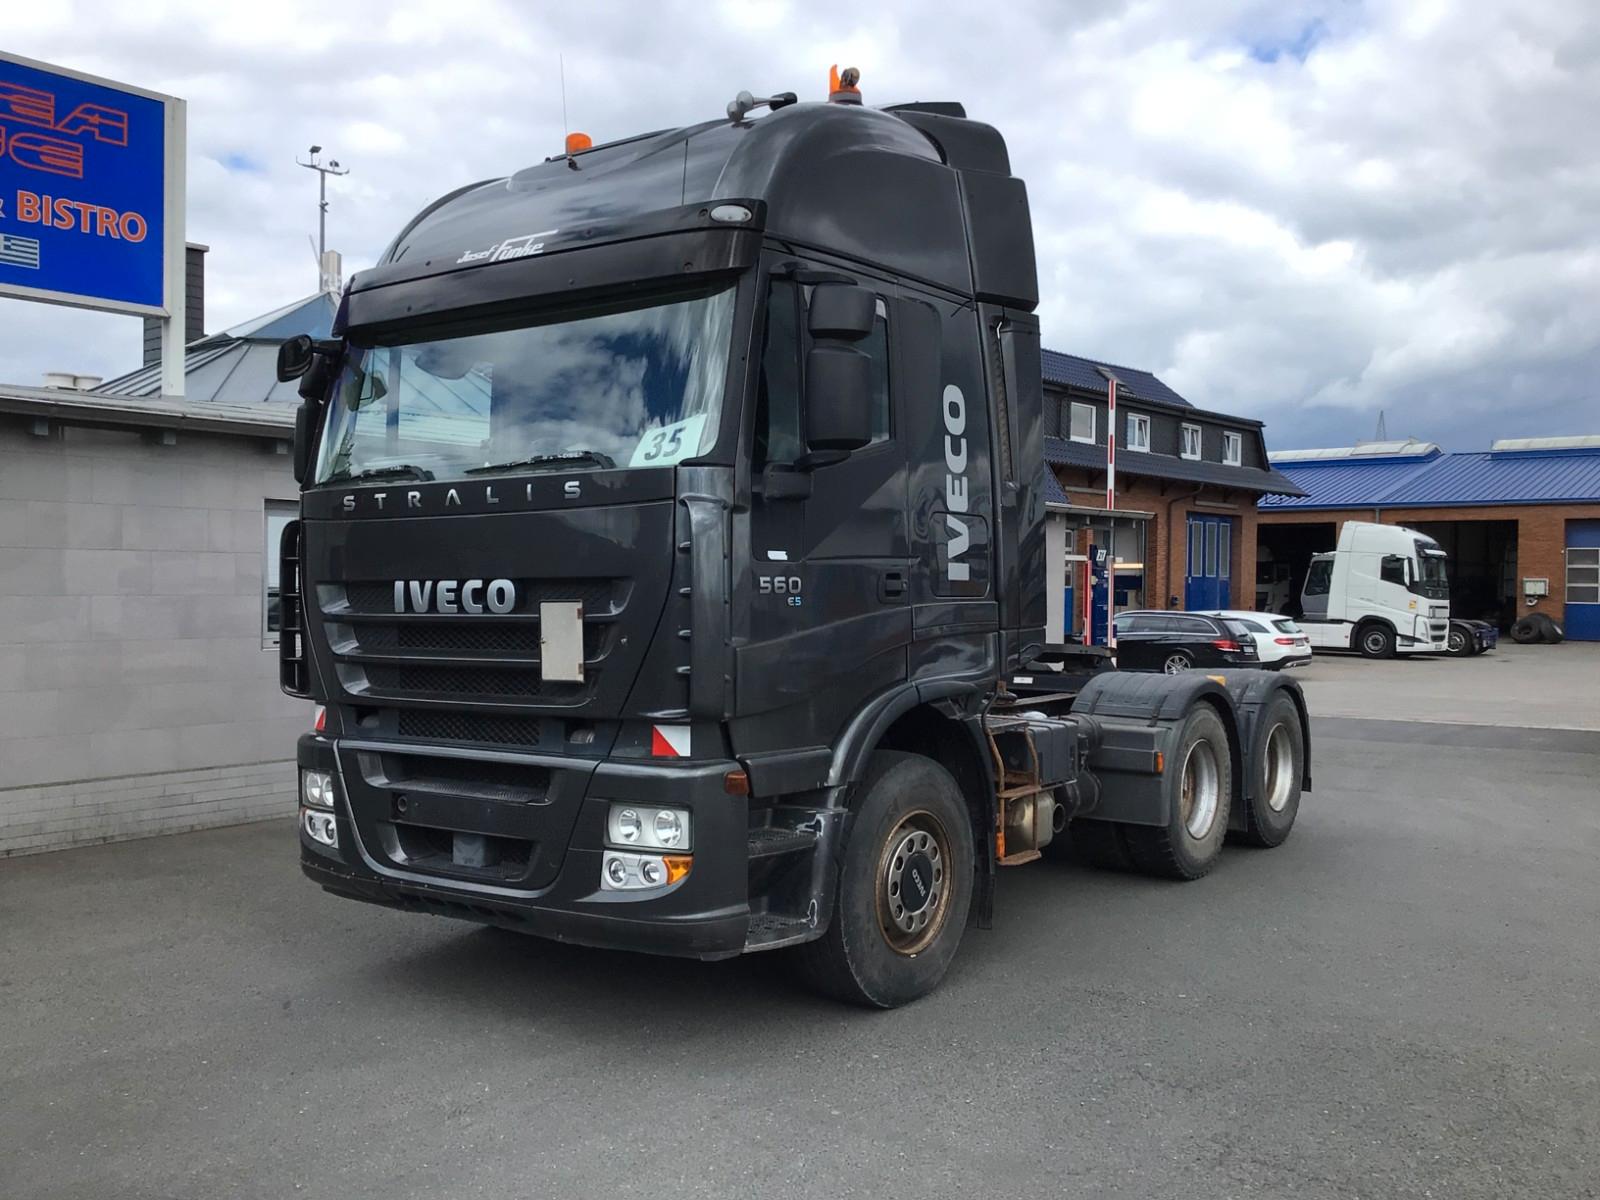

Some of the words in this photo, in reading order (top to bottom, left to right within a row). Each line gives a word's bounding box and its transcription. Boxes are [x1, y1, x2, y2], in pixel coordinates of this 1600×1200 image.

[17, 190, 147, 243] BISTRO
[456, 244, 499, 264] Josef
[490, 229, 559, 263] Funke
[644, 427, 686, 461] 35
[343, 480, 581, 511] STRALIS
[943, 384, 970, 580] IVECO
[394, 579, 515, 614] IVECO
[759, 576, 801, 594] 560
